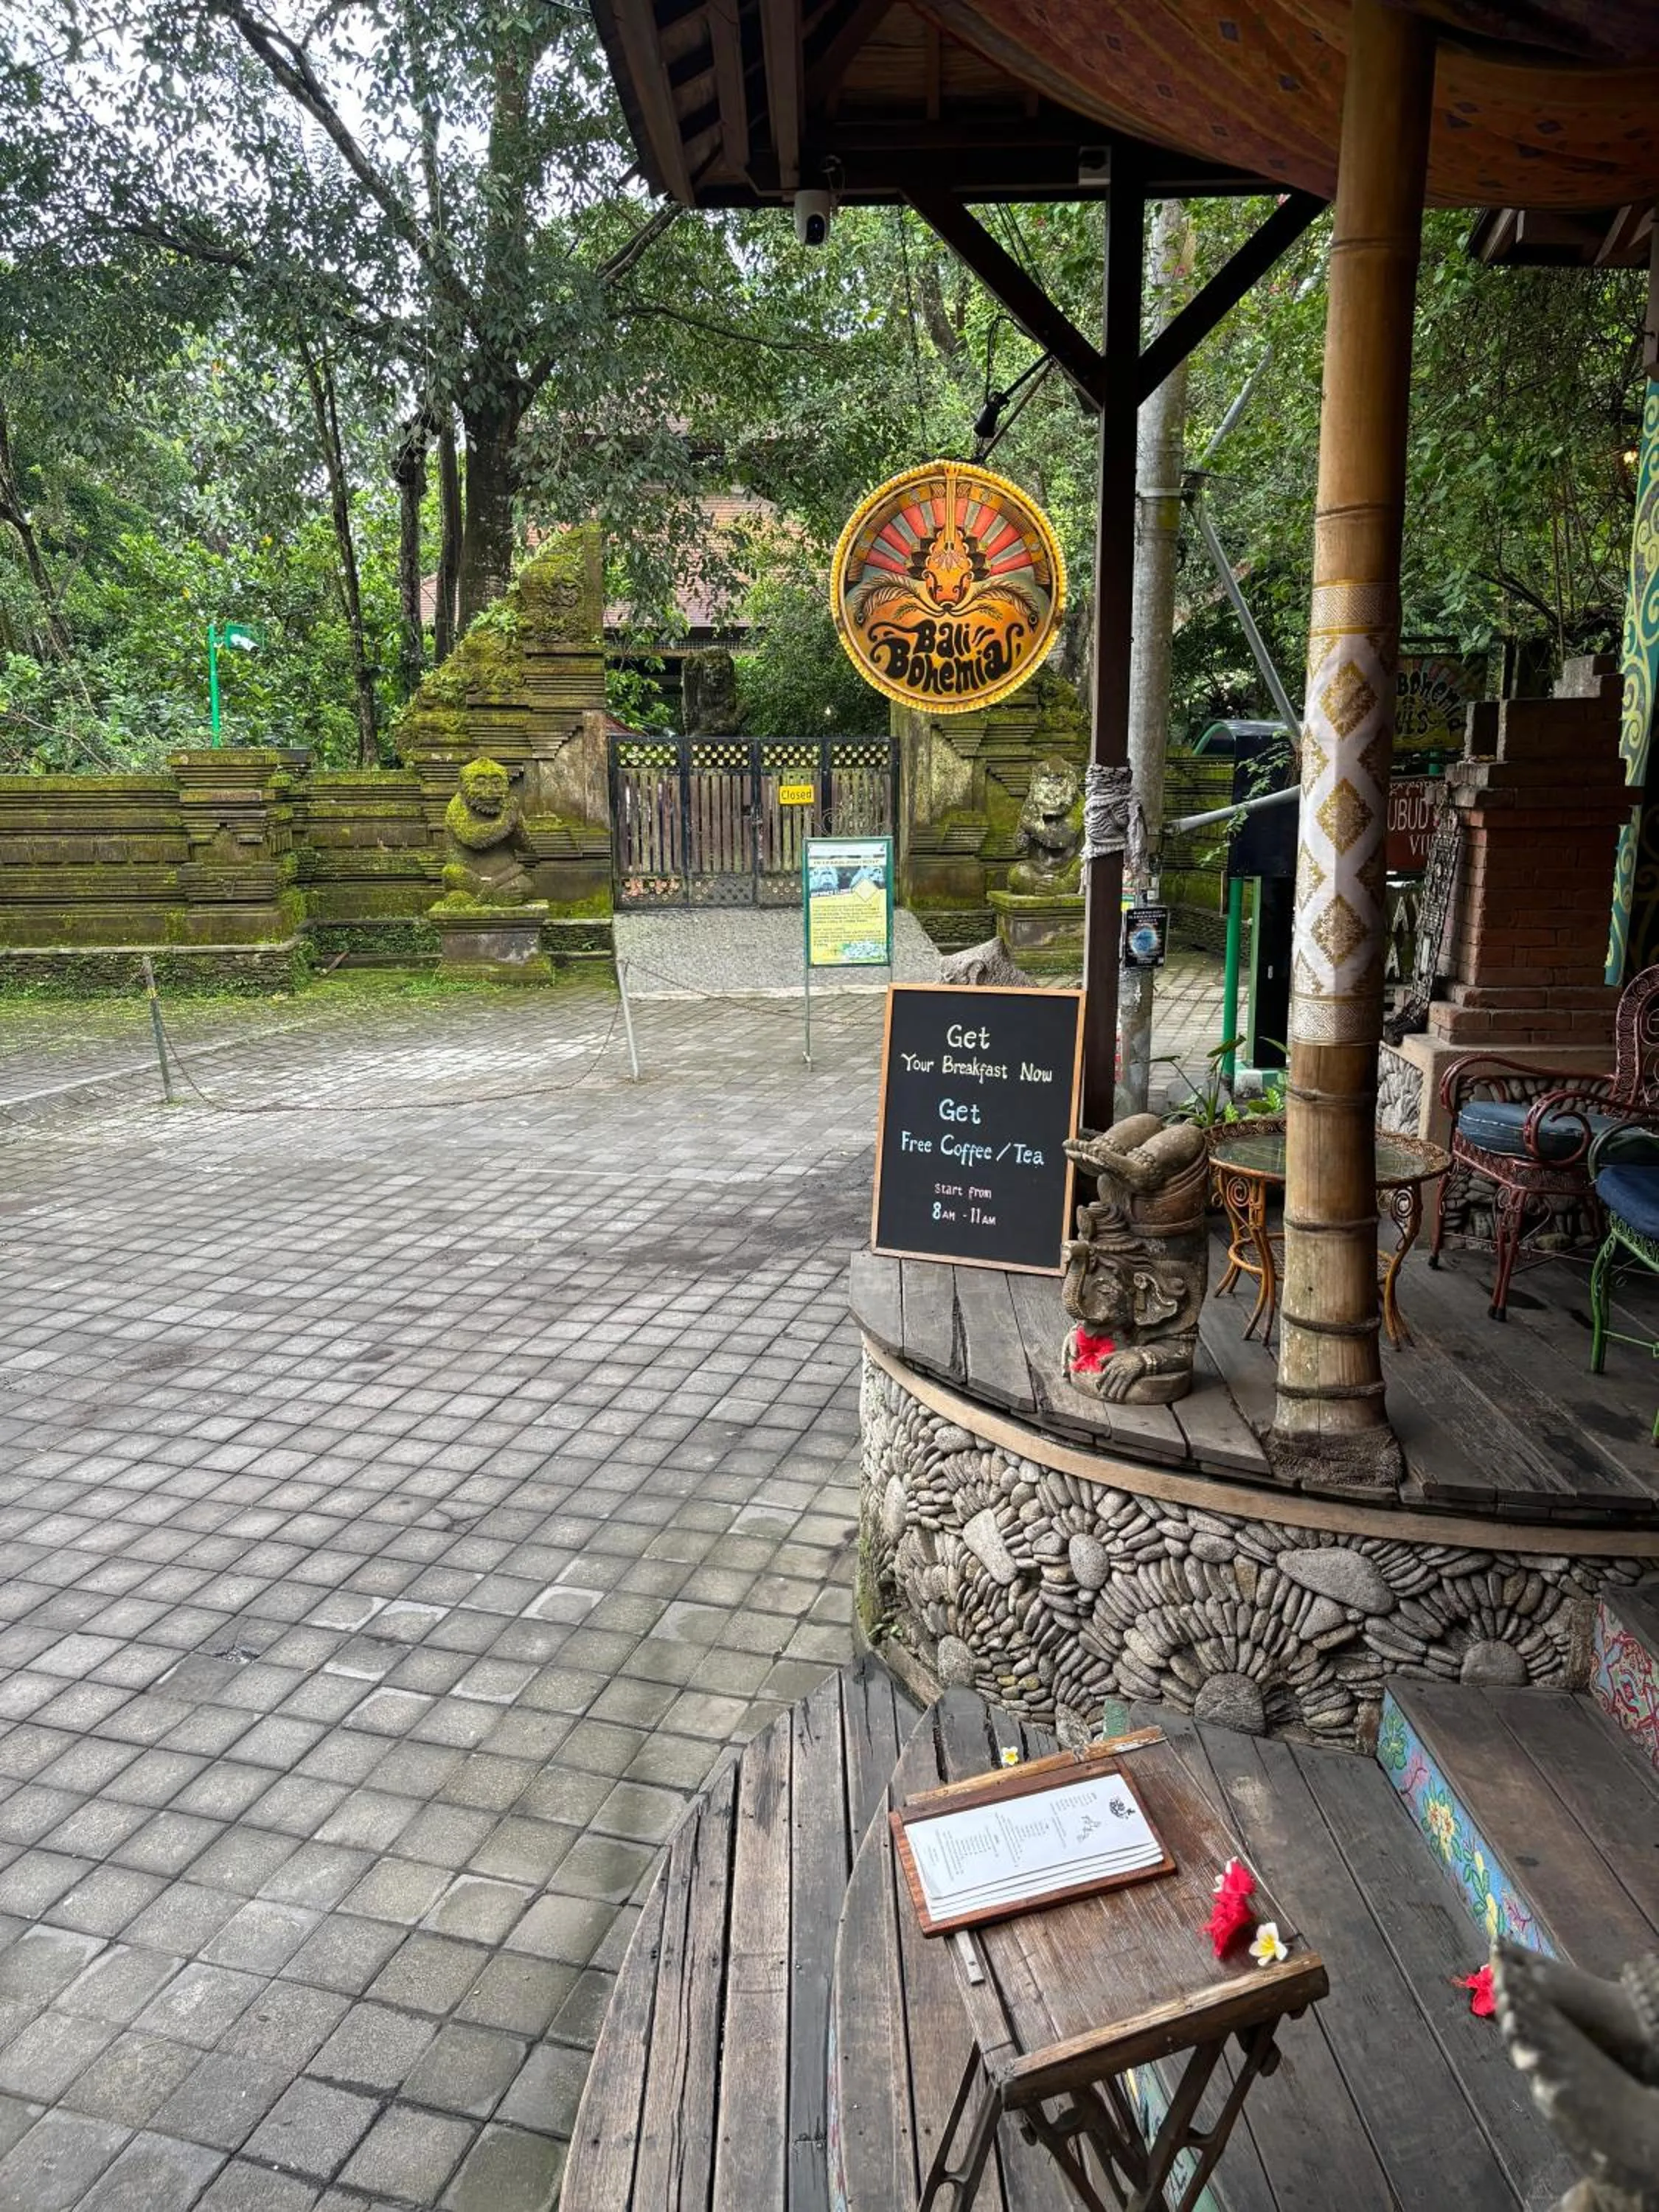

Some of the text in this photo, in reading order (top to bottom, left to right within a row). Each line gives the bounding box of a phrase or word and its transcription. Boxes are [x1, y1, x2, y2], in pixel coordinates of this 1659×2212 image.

[913, 619, 970, 658] Bali
[870, 624, 1023, 695] Bohemia
[781, 789, 812, 801] Closed
[1387, 797, 1429, 832] UBUD
[947, 1024, 990, 1049] Get
[901, 1053, 1053, 1084] Your Breakfast Now
[939, 1099, 981, 1124] Get
[901, 1130, 933, 1152] Free
[934, 1183, 992, 1200] start from
